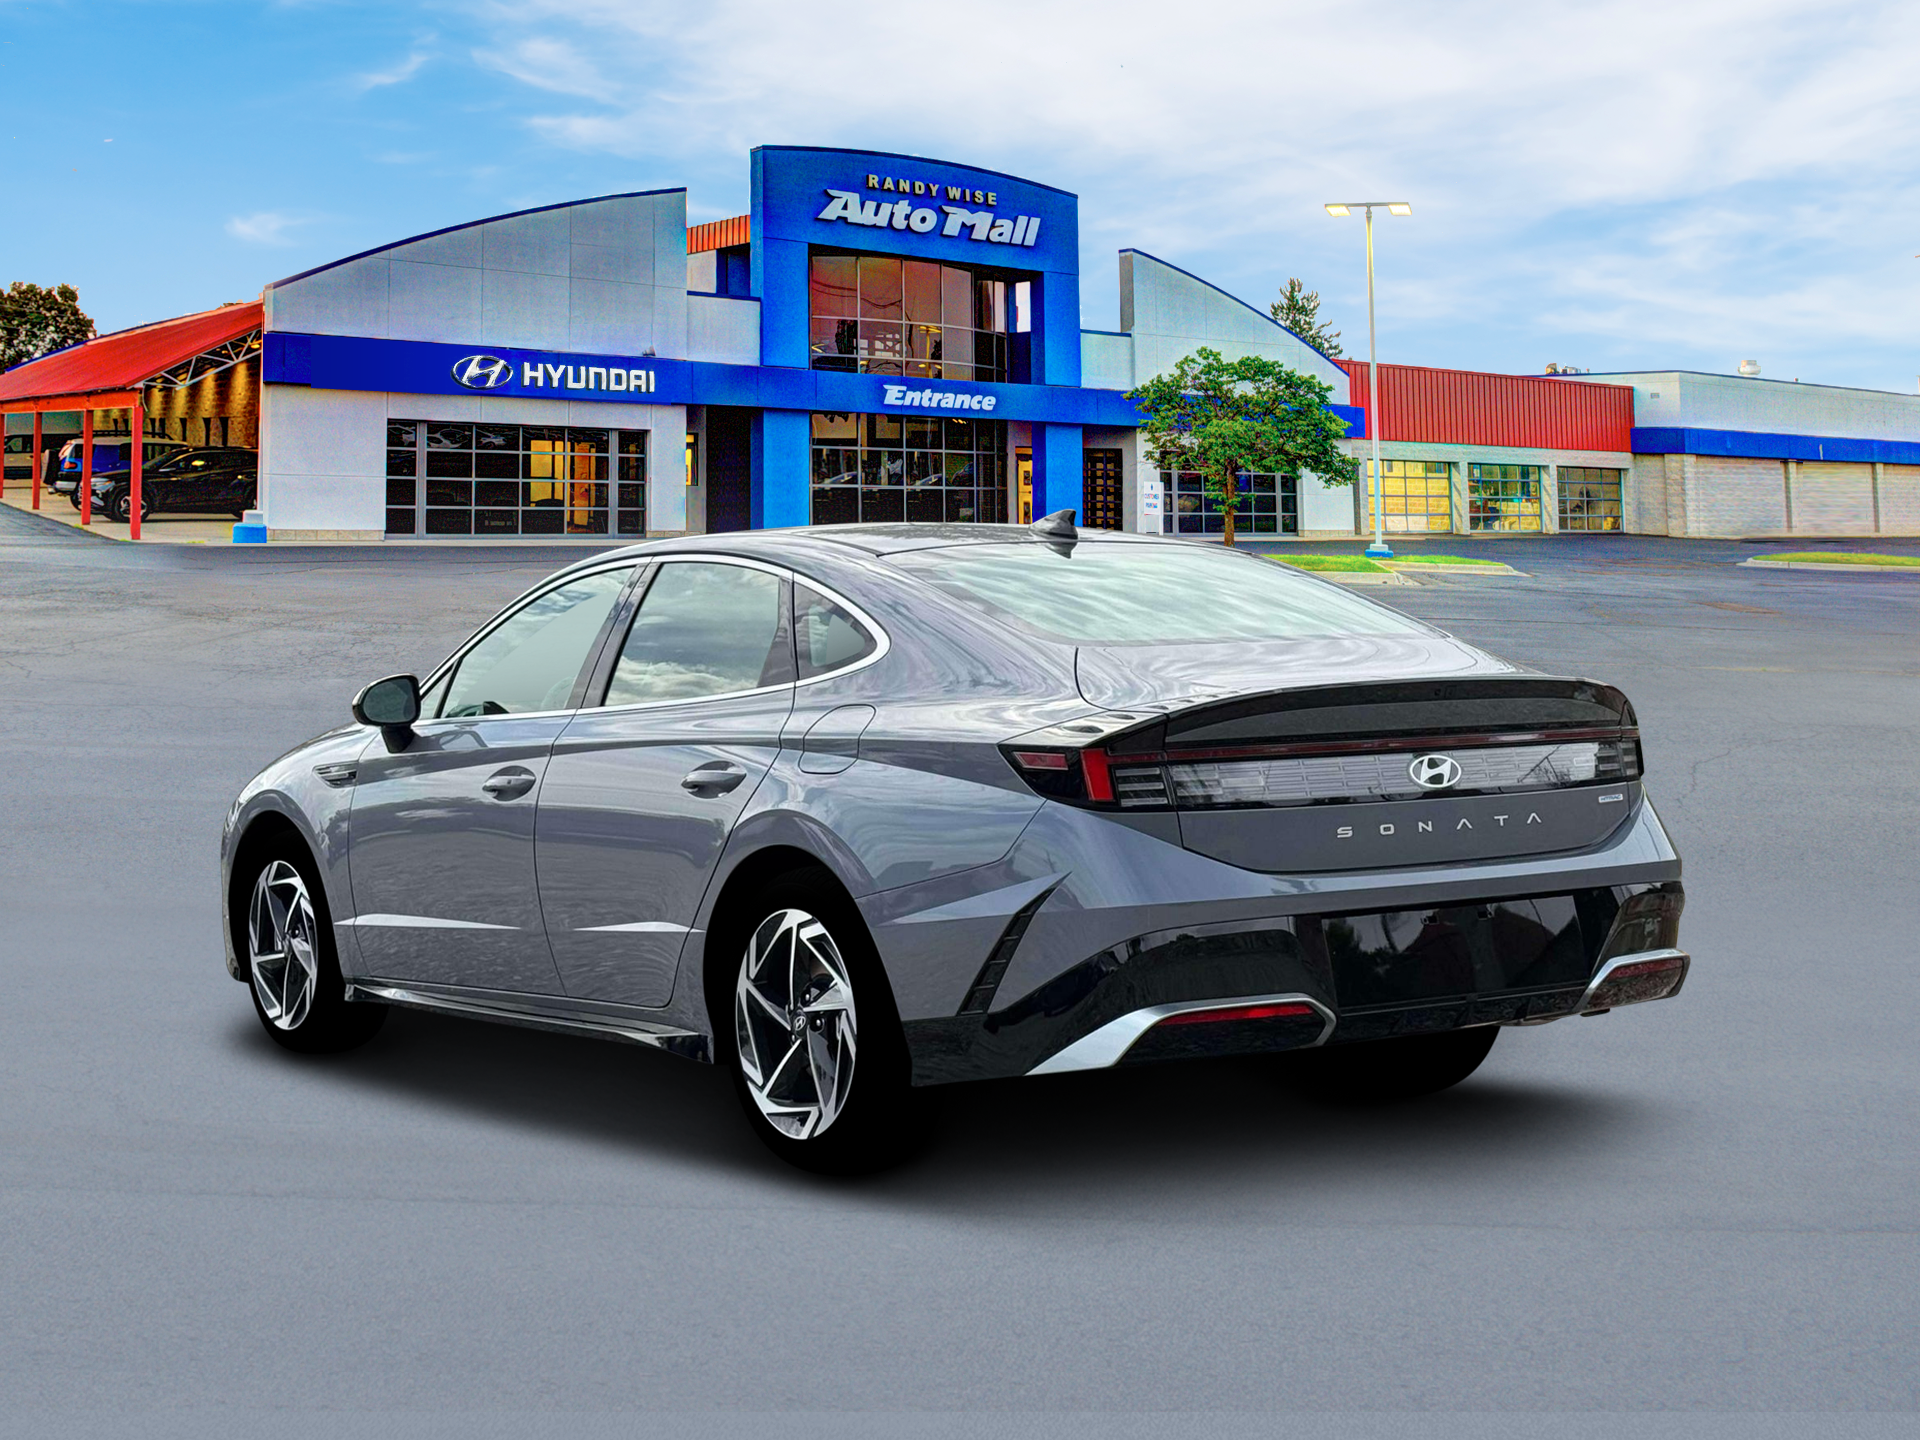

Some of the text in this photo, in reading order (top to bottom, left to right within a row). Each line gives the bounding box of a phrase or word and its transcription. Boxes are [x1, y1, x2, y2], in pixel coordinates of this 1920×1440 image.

[866, 173, 998, 205] RANDY WISE
[816, 188, 1041, 247] Auto Mall
[522, 361, 655, 393] HYUNDAI
[882, 384, 997, 411] Entrance
[1336, 812, 1542, 838] SONATA
